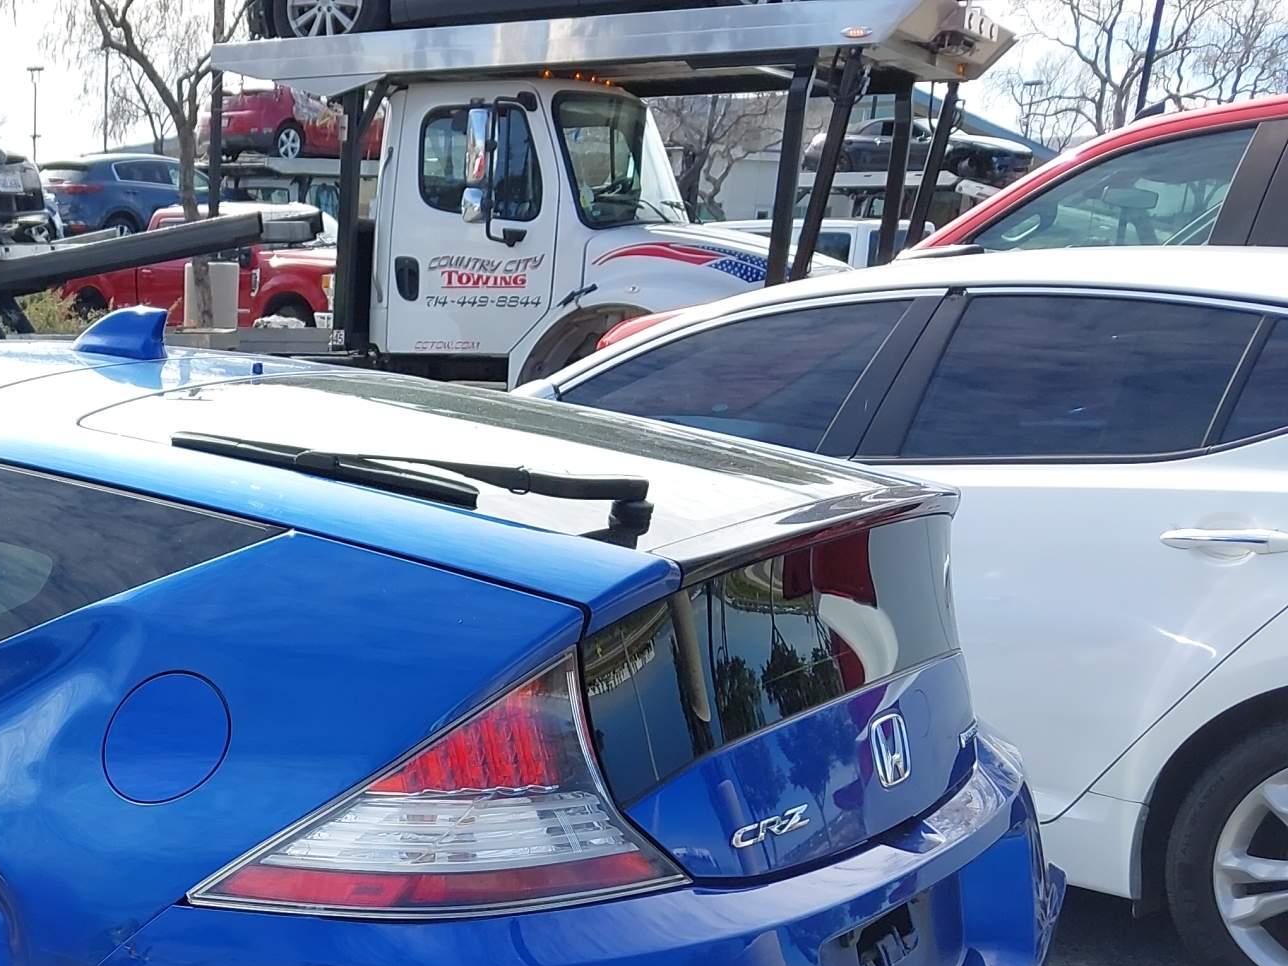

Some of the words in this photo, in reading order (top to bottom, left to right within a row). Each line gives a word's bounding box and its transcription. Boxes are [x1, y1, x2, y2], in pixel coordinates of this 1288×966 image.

[428, 255, 502, 273] COUNTRY
[503, 254, 545, 273] CITY
[440, 270, 527, 287] TOWING
[425, 295, 542, 308] 714-449-8844
